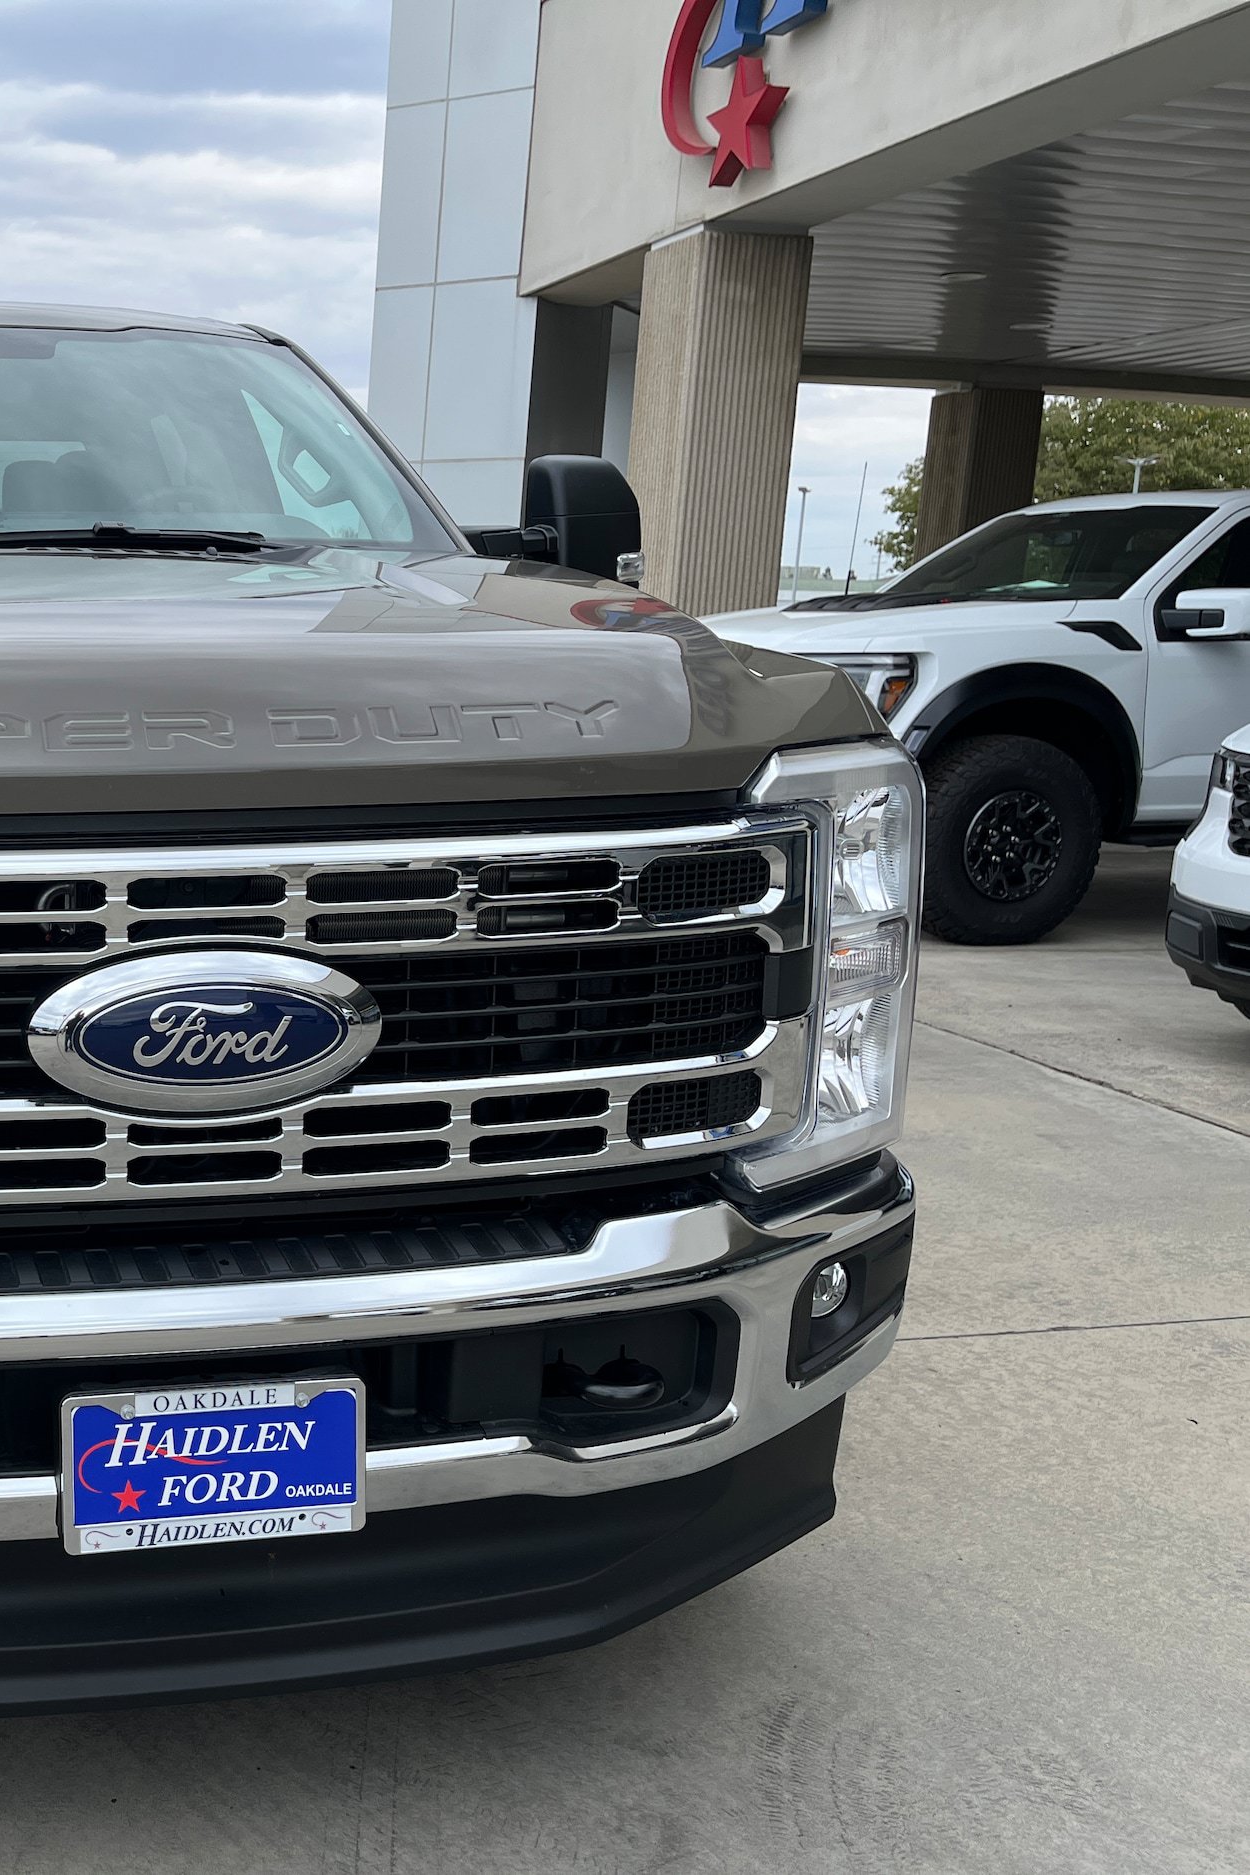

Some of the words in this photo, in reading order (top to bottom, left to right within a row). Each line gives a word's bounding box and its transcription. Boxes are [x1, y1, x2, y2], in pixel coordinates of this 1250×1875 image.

[266, 700, 620, 747] DUTY
[133, 1001, 293, 1068] Ford
[153, 1388, 278, 1412] OAKDALE
[104, 1420, 316, 1468] HAIDLEN
[157, 1470, 280, 1507] FORD
[285, 1482, 352, 1498] OAKDALE
[135, 1517, 296, 1548] HAIDLEN.COM
